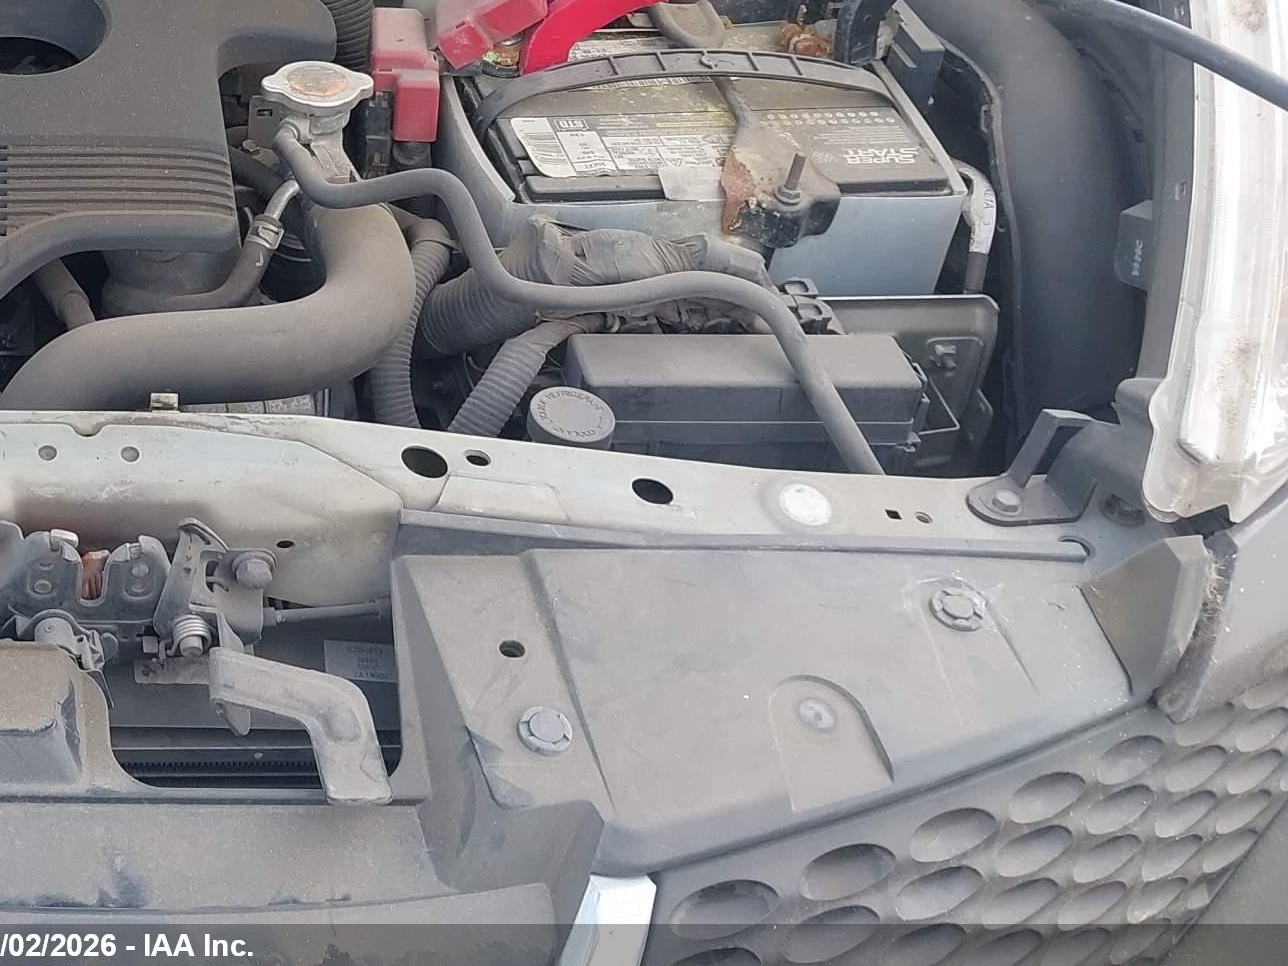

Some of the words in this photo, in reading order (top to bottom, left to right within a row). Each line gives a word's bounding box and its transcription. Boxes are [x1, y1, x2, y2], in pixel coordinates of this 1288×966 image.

[559, 120, 585, 129] STD
[843, 148, 919, 157] START
[845, 154, 916, 164] SUPER
